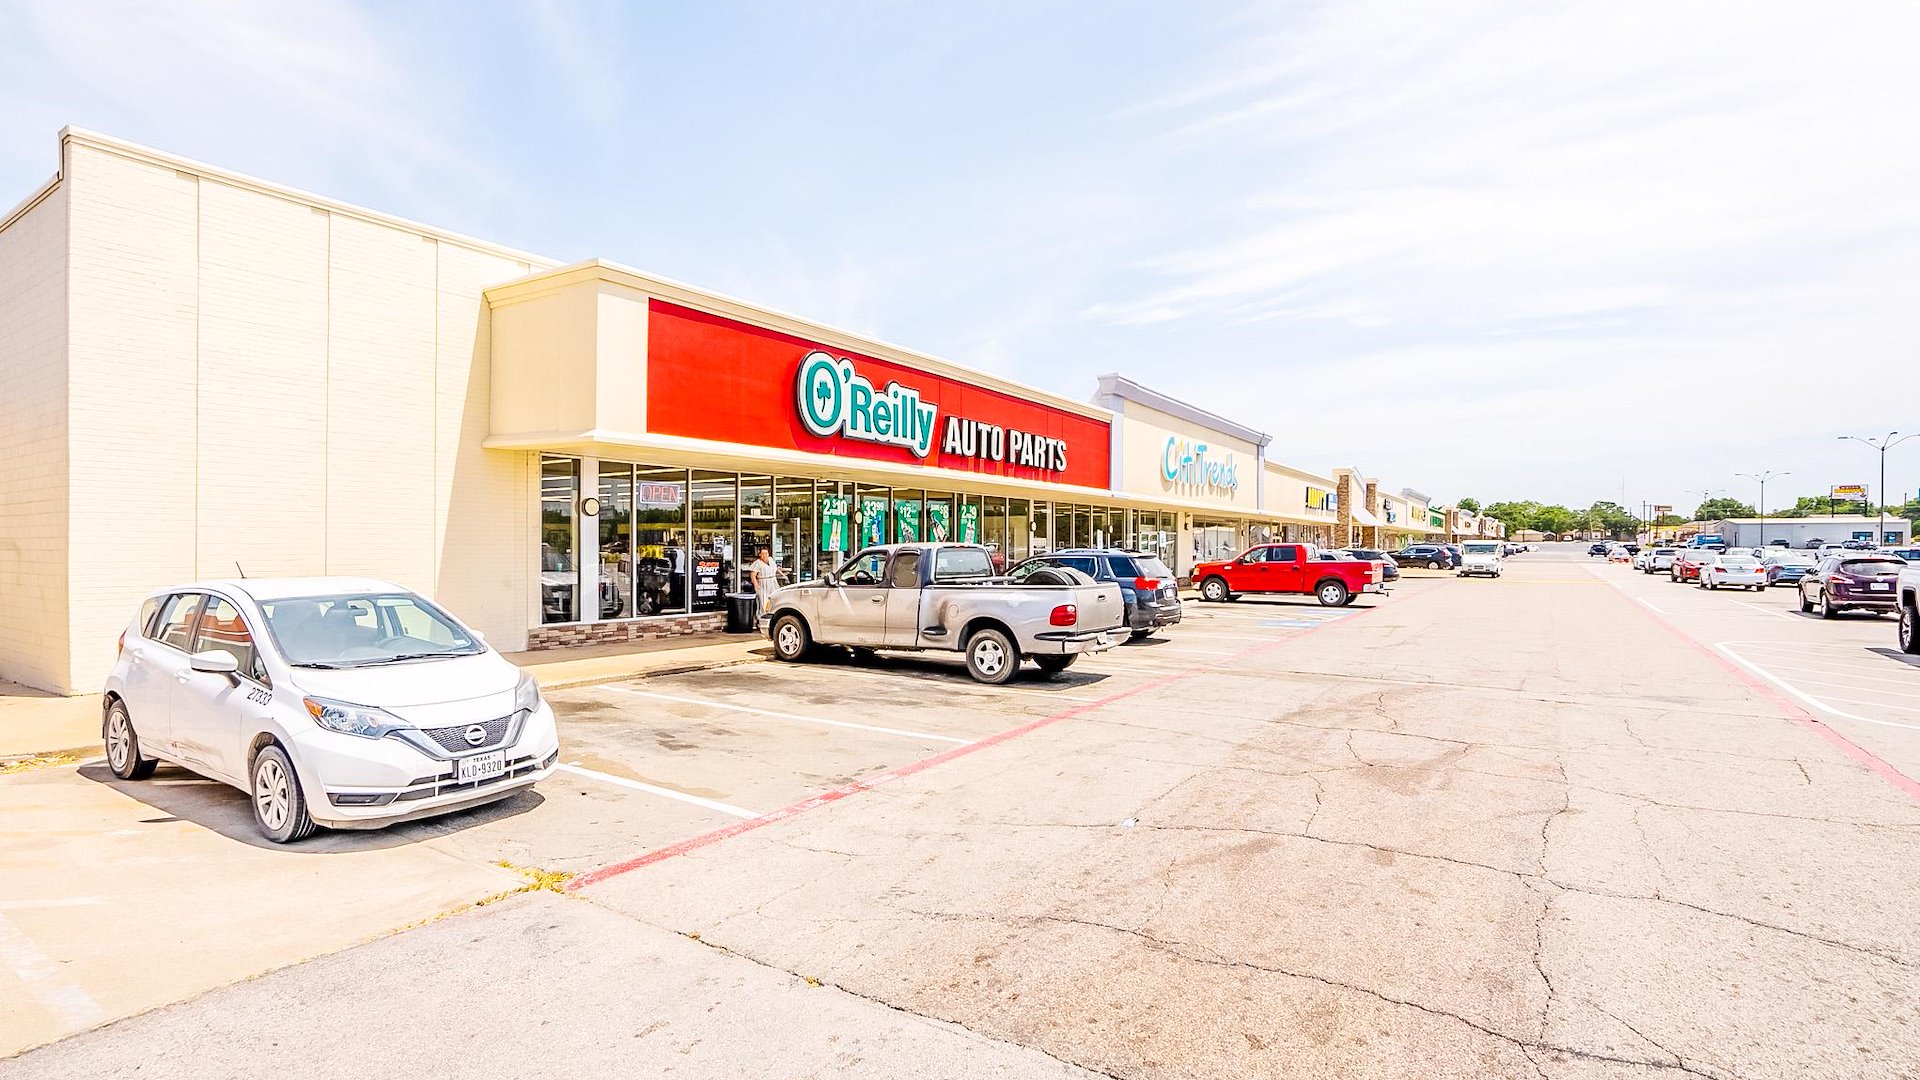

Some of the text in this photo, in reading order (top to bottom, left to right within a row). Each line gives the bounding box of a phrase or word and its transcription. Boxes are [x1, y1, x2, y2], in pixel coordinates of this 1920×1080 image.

[803, 358, 936, 454] O'Reilly
[944, 415, 1067, 472] AUTO PARTS
[643, 485, 678, 502] OPEN
[246, 687, 273, 706] 27333
[473, 755, 491, 763] TEXAS
